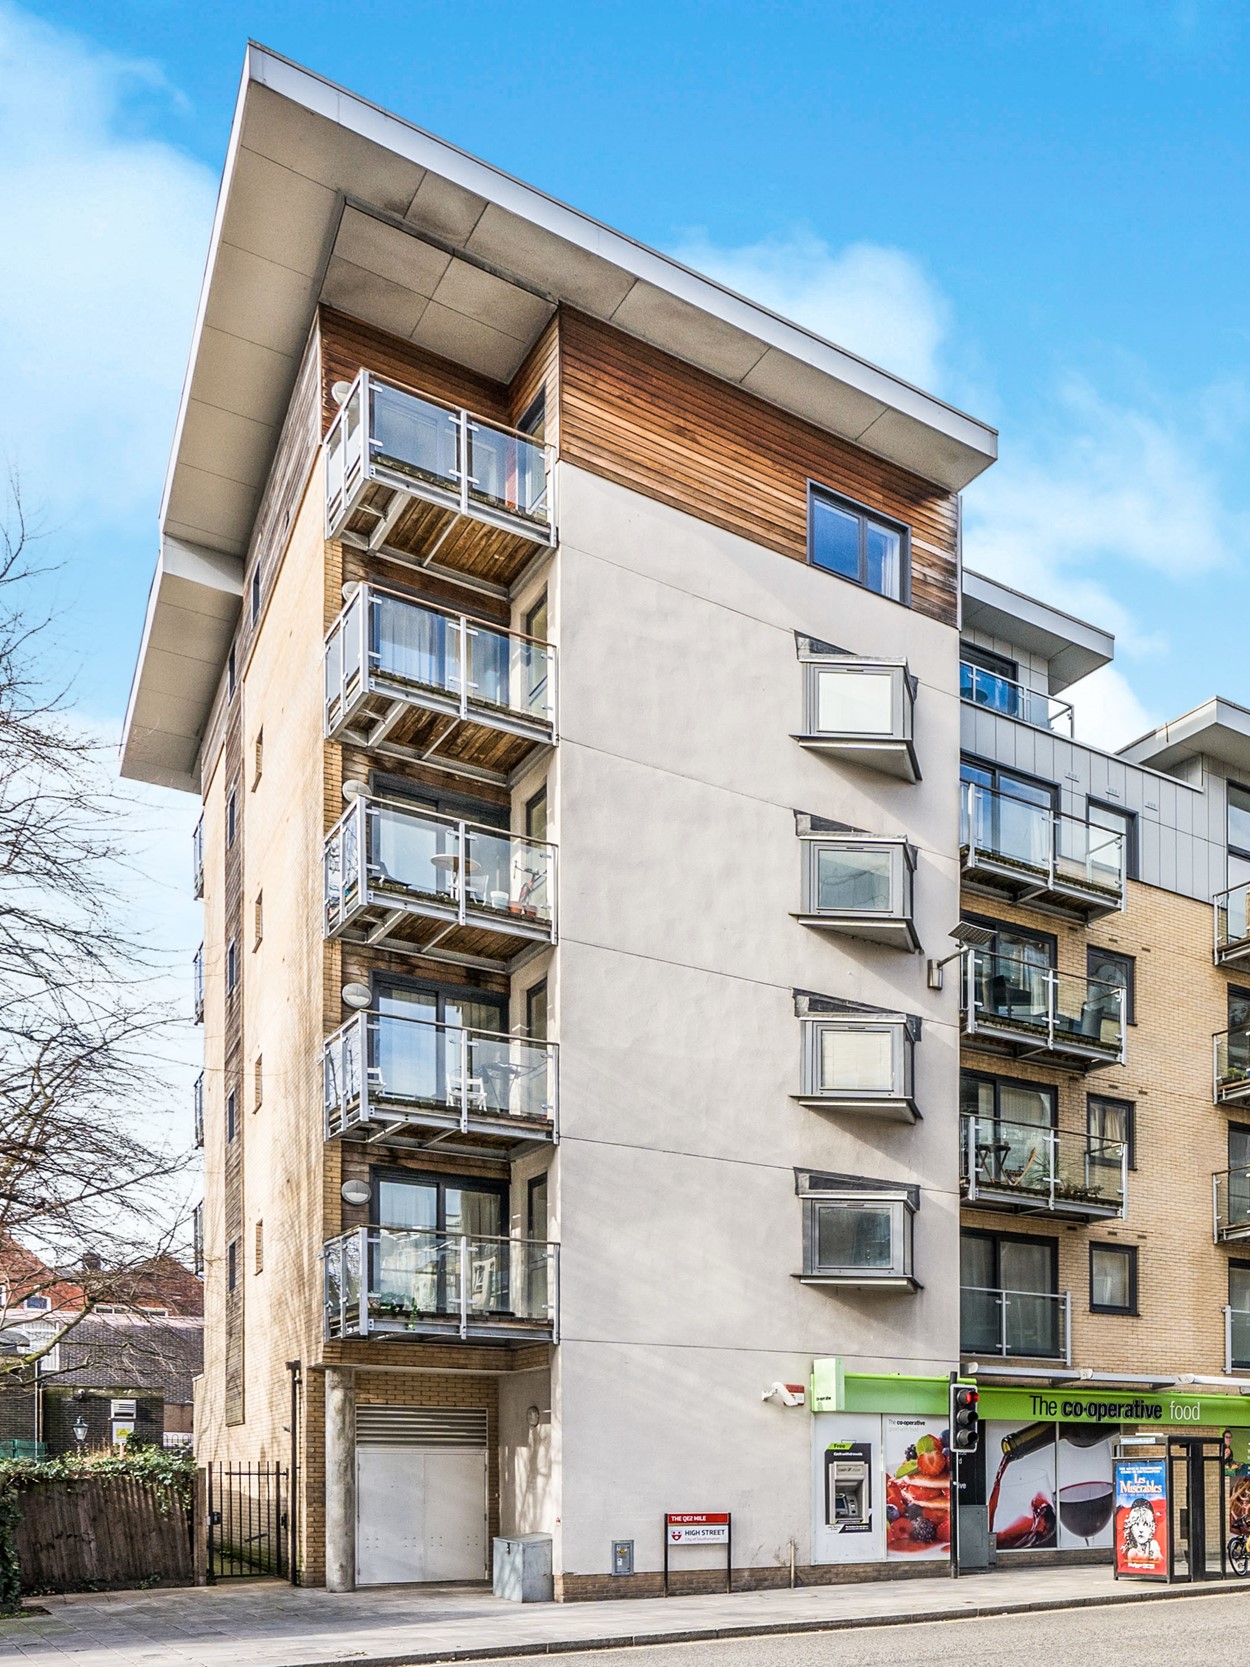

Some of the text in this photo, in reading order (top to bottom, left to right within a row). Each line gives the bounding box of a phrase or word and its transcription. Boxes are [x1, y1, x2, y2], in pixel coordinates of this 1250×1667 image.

[1029, 1395, 1200, 1421] The co-operative food
[1134, 1474, 1146, 1484] Les
[1120, 1480, 1162, 1493] Misérables
